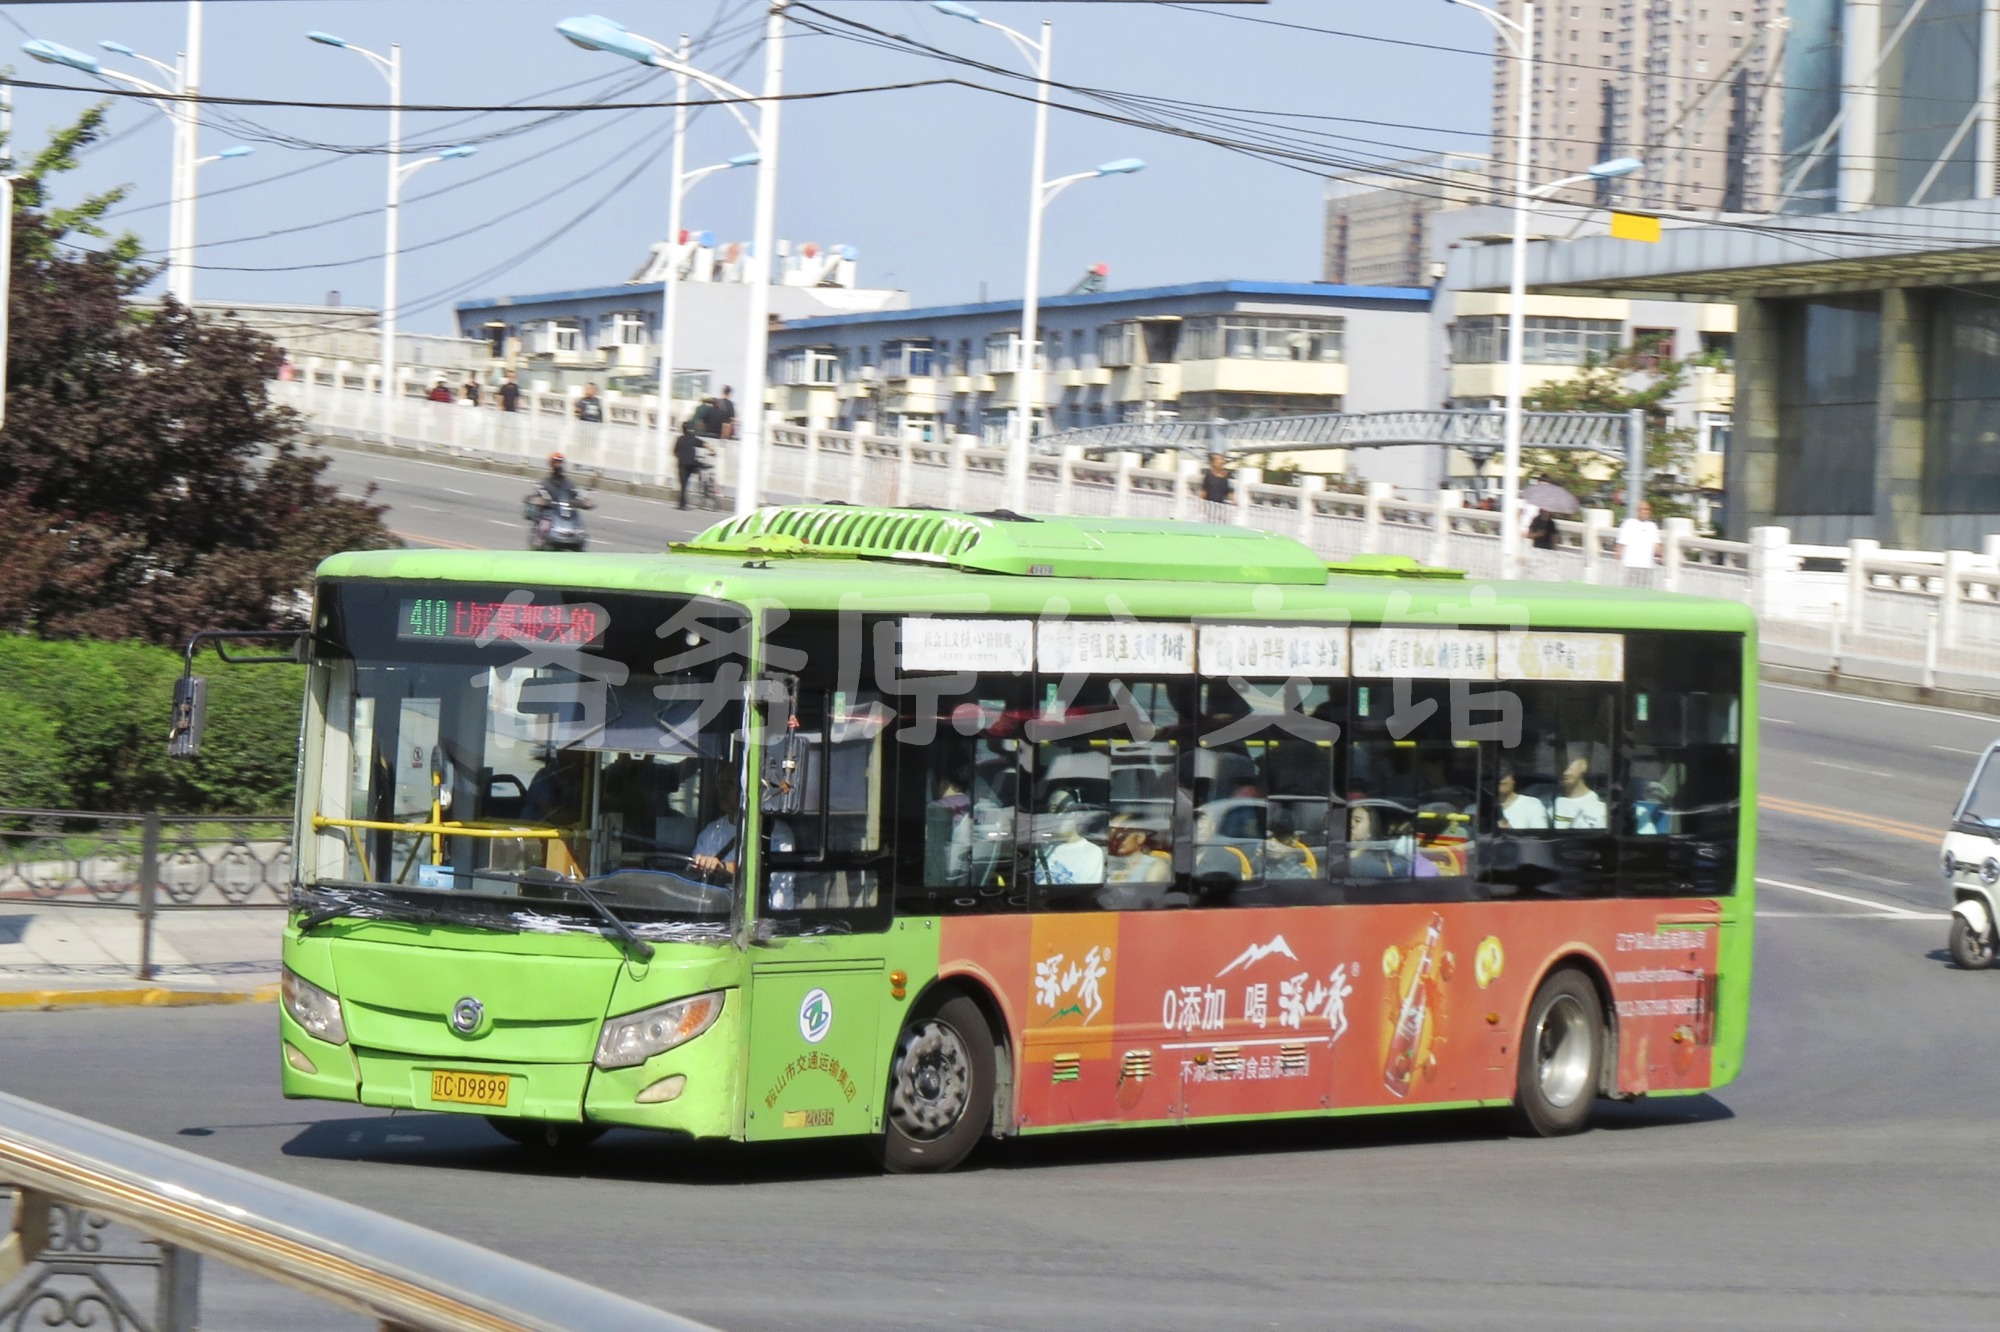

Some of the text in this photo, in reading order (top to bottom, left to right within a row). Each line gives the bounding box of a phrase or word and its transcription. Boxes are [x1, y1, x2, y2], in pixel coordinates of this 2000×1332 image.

[410, 599, 447, 636] 410
[1162, 983, 1227, 1032] 0添加
[1244, 983, 1268, 1029] 喝
[764, 1051, 858, 1110] 鞍山市交通运输集团
[805, 1109, 834, 1127] 2086
